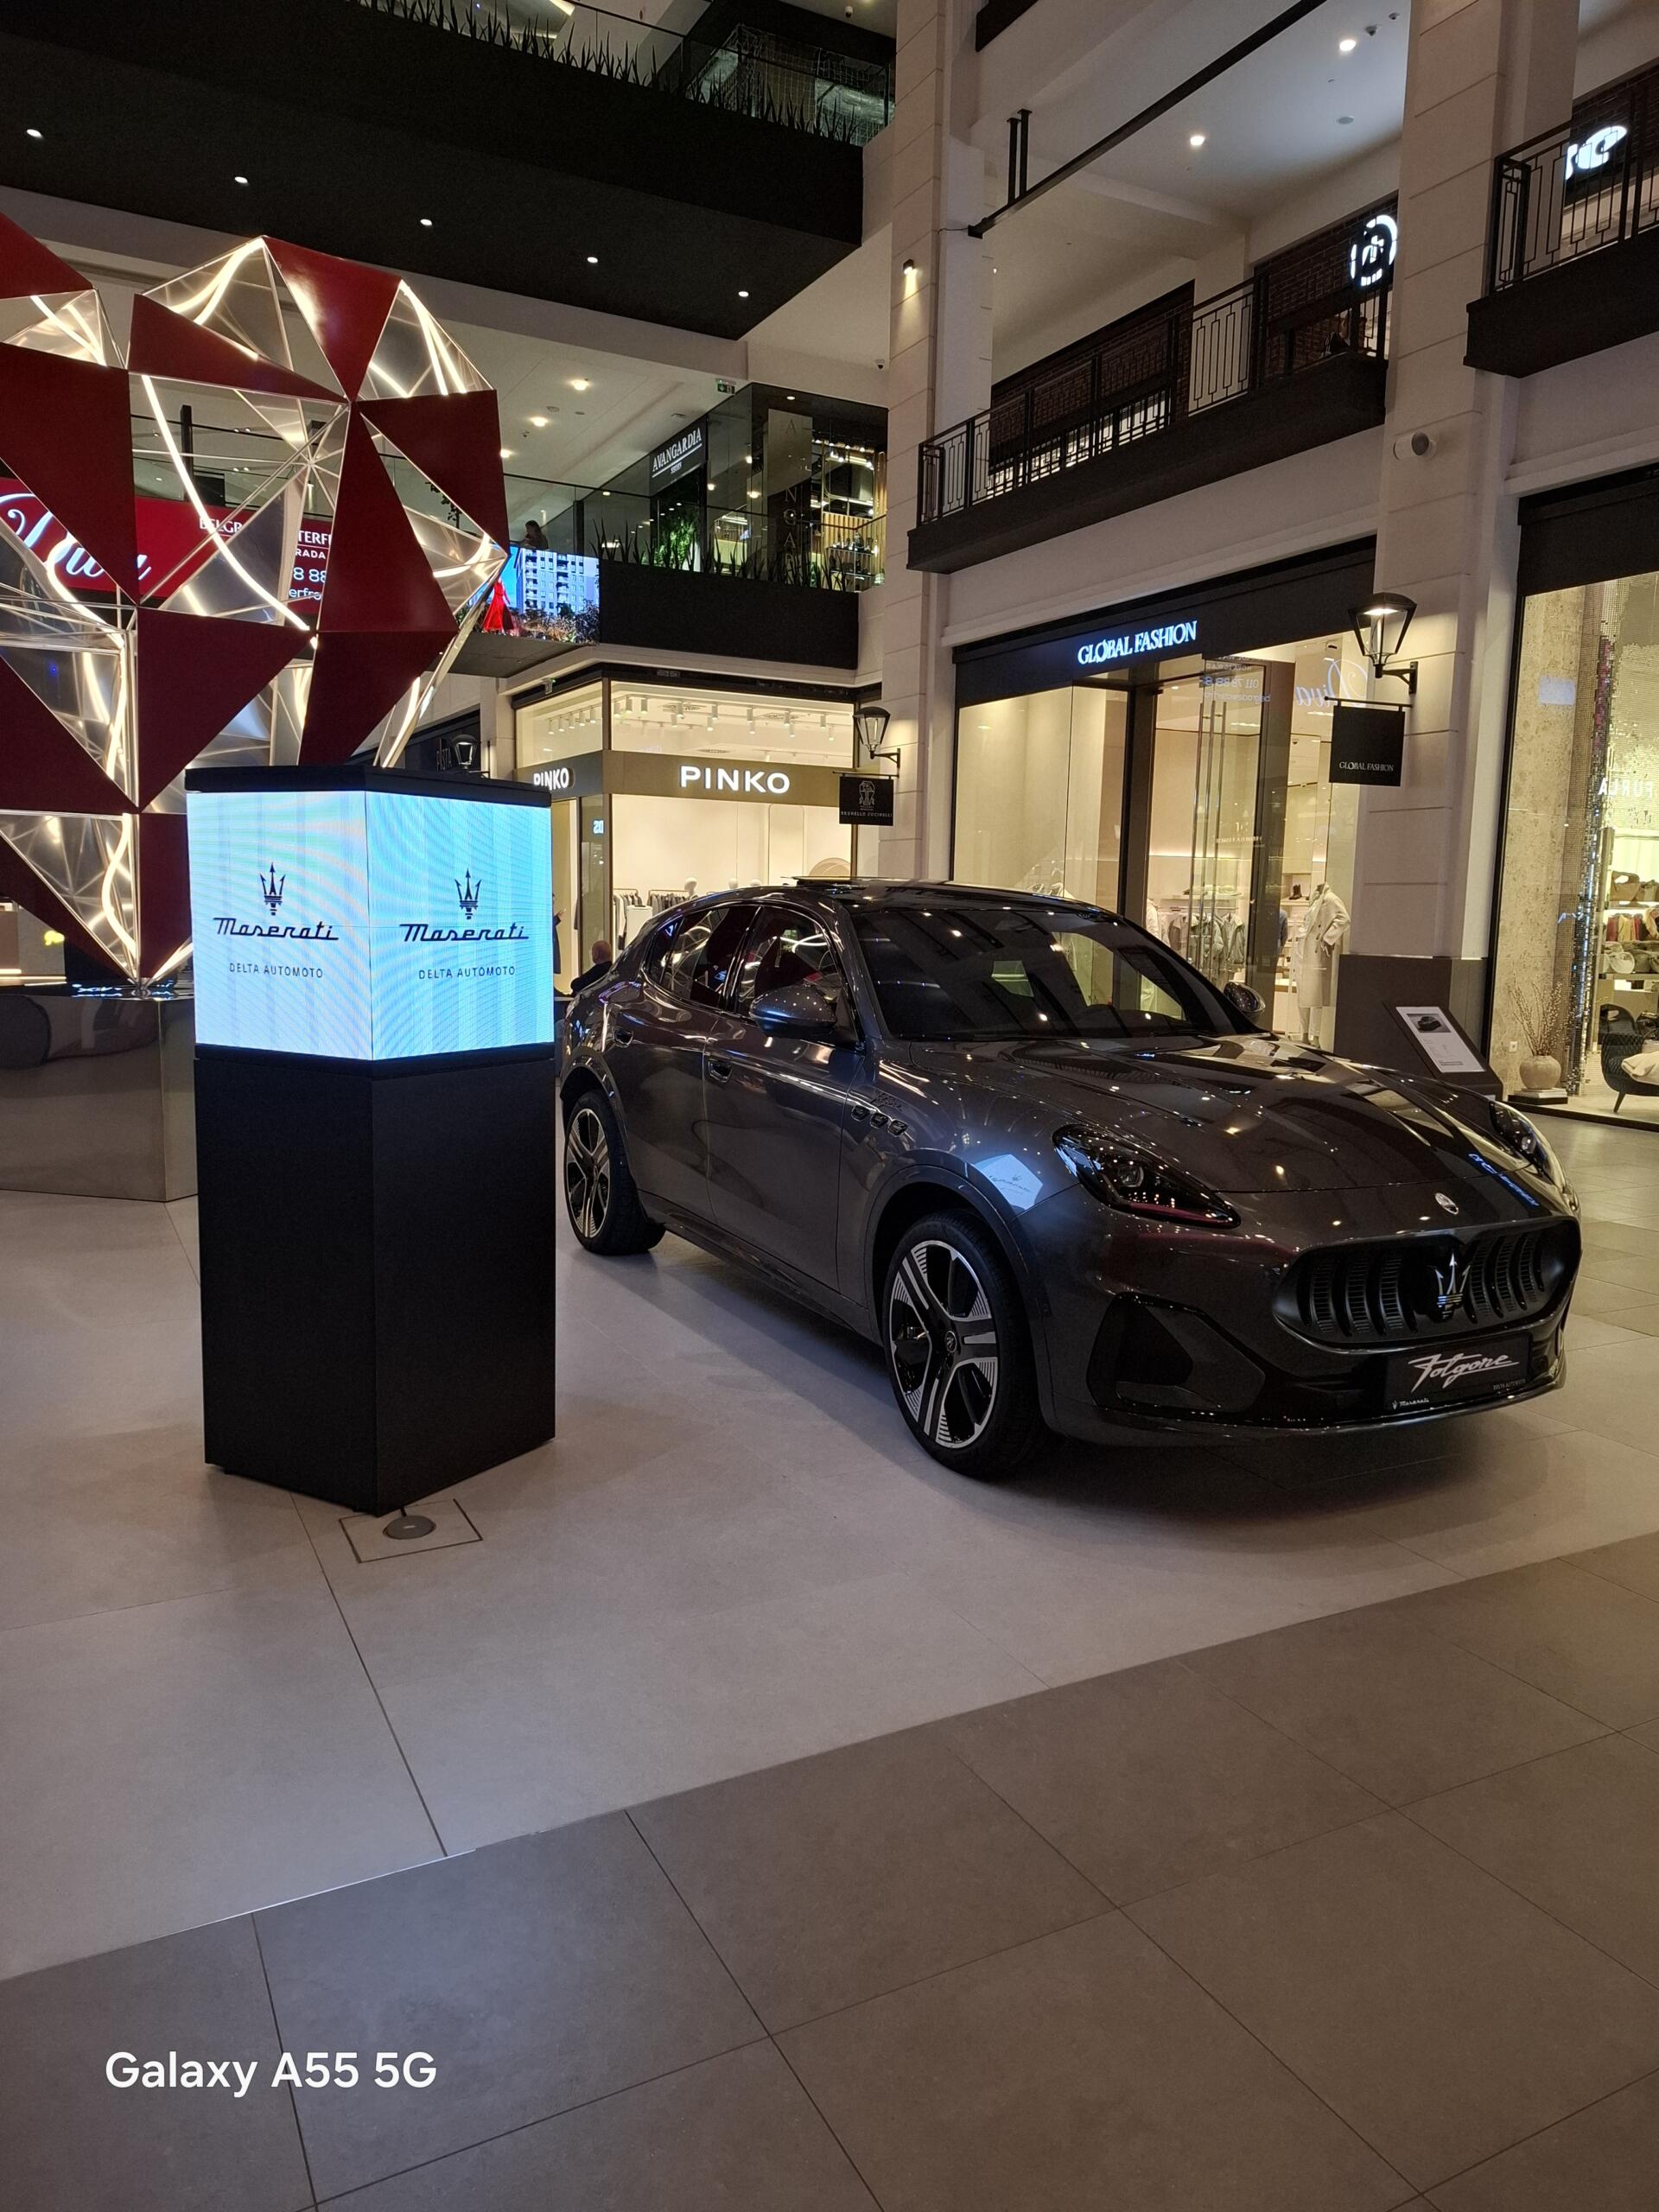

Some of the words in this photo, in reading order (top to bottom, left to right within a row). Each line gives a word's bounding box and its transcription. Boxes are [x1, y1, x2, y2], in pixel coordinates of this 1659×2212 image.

[652, 427, 702, 473] AVANGARDIA
[298, 530, 333, 545] TERF
[1077, 636, 1134, 664] GLOBAL
[1134, 620, 1198, 653] FASHION
[1339, 761, 1366, 772] GLOBAL
[1367, 762, 1395, 772] FASHION
[533, 767, 570, 791] PINKO
[680, 765, 791, 794] PINKO
[213, 917, 340, 942] Maserati
[399, 920, 530, 943] Maserati
[229, 963, 259, 974] DELTA
[263, 965, 324, 979] AUTOMOTO
[418, 969, 454, 980] DELTA
[456, 965, 517, 978] AUTOMOTO
